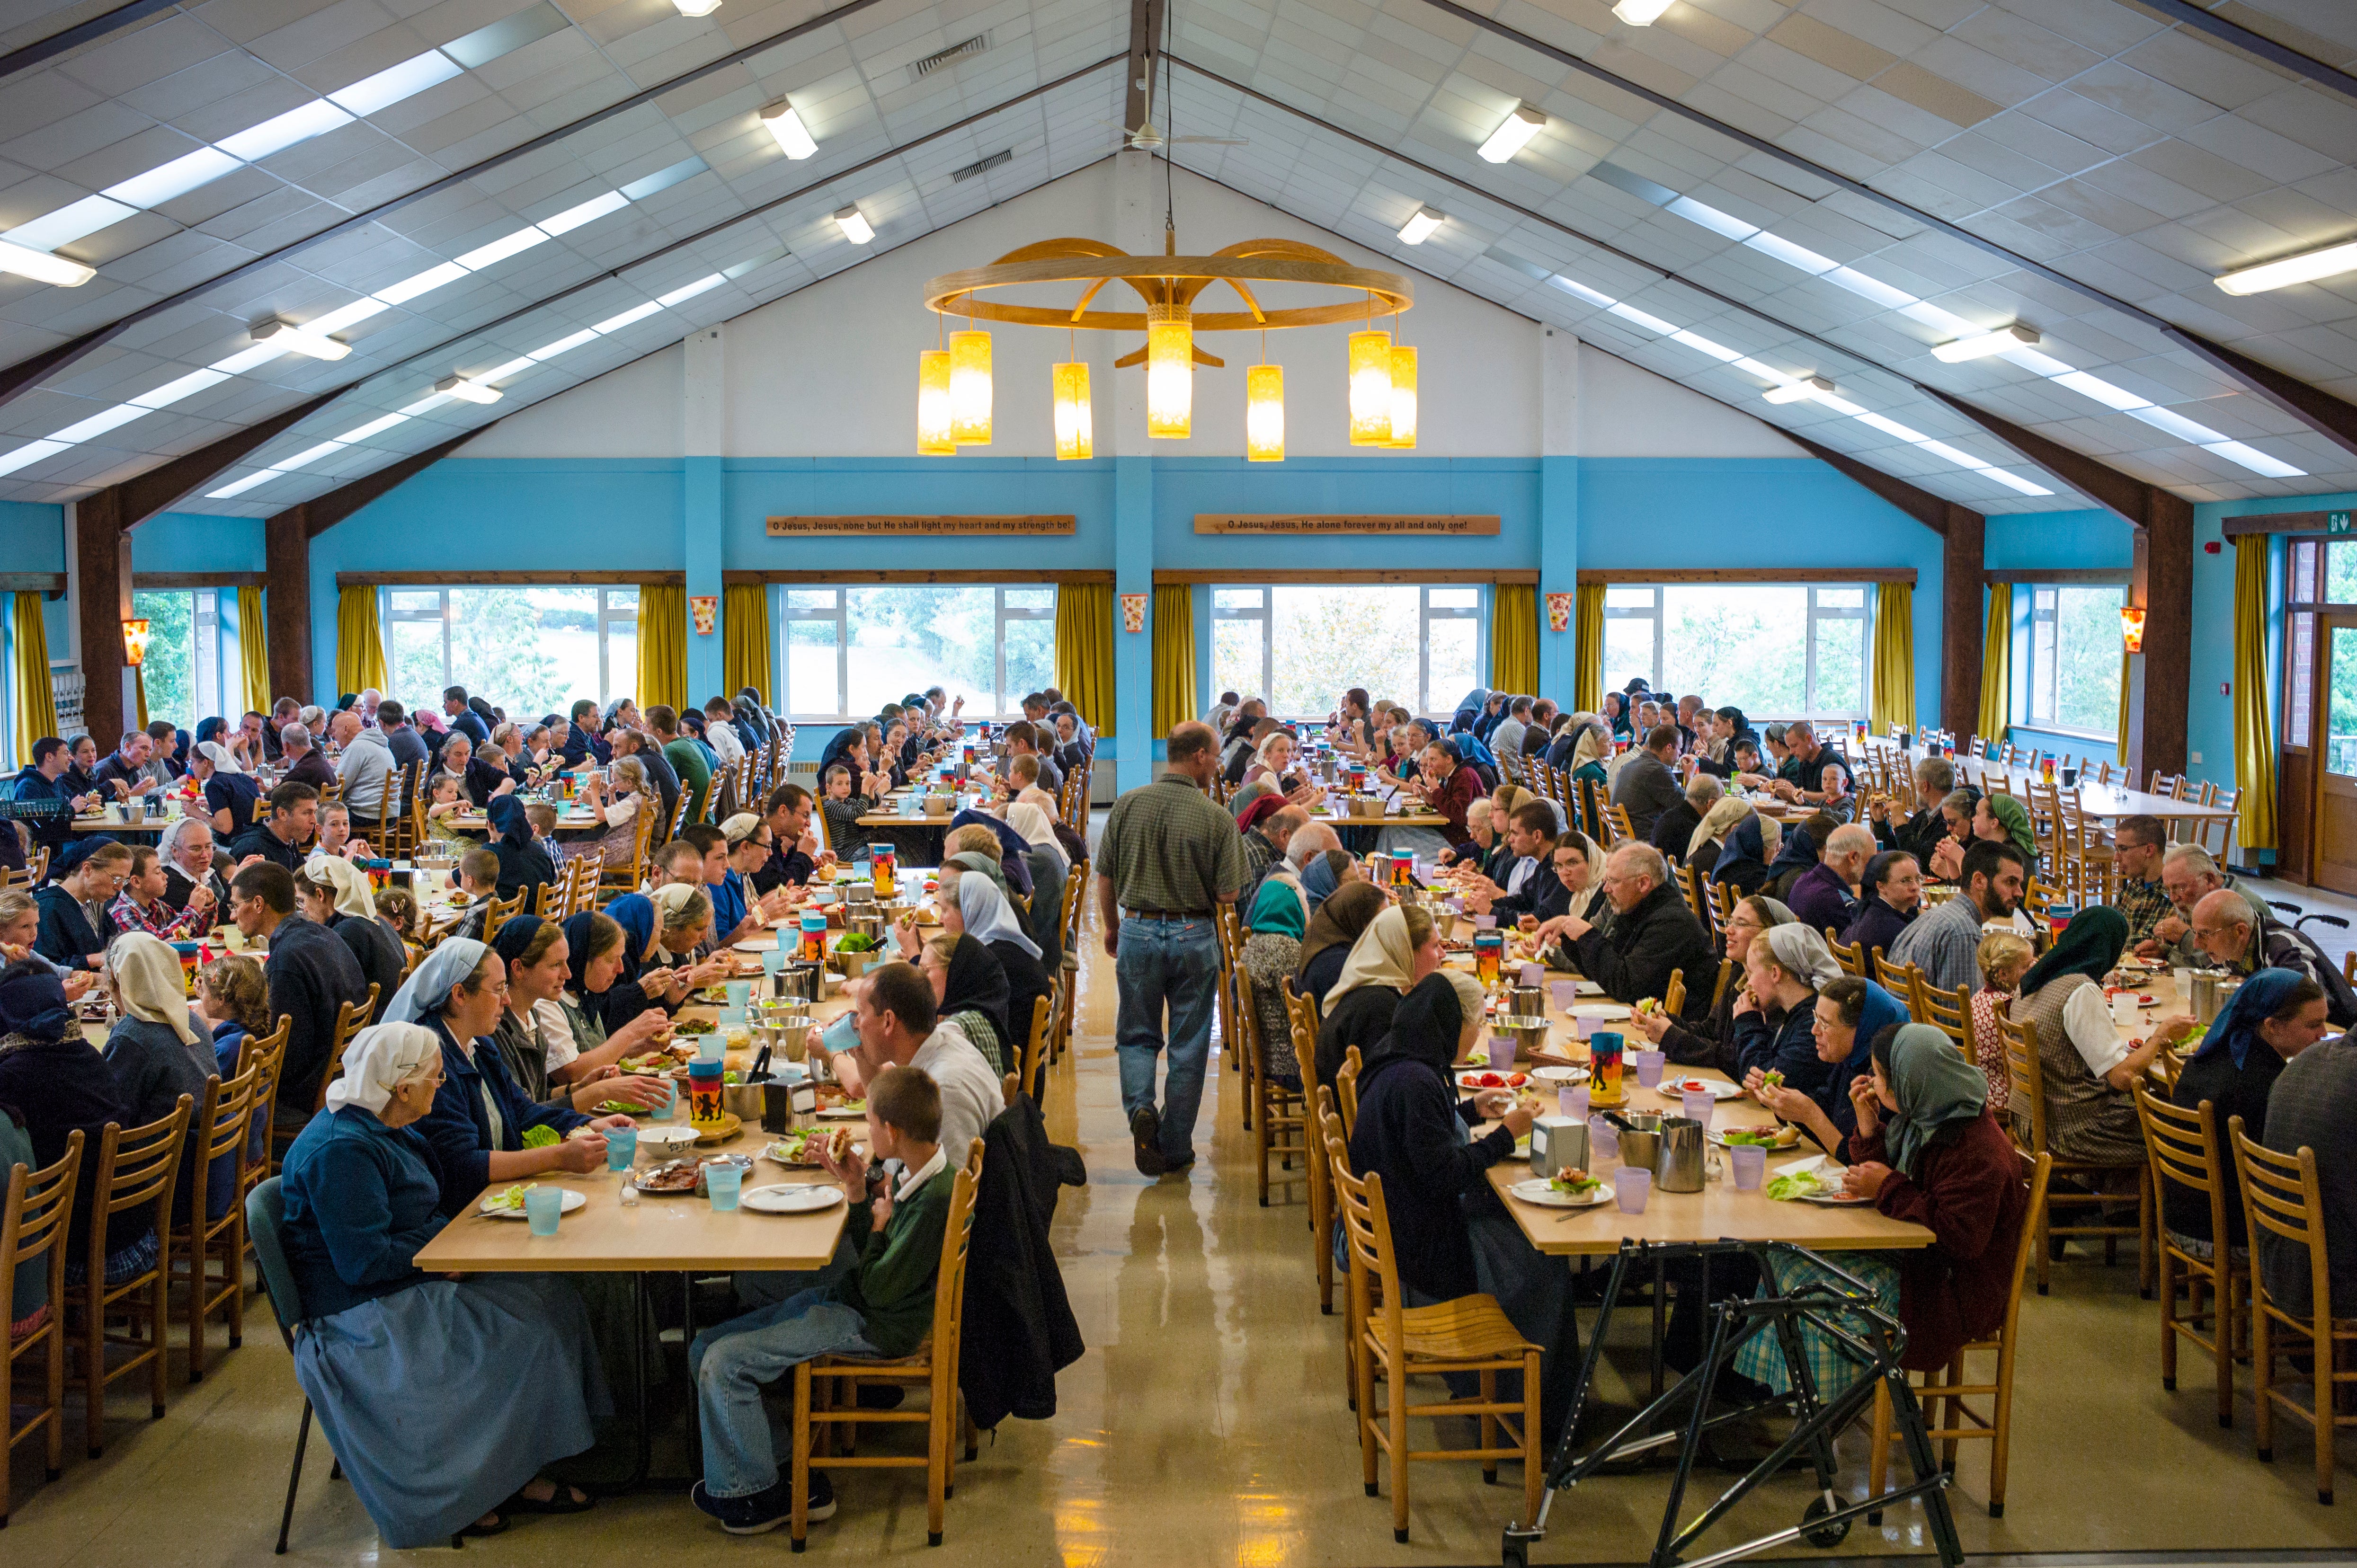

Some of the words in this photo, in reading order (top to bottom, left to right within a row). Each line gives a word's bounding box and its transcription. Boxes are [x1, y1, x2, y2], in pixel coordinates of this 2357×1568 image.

[773, 522, 779, 530] O
[782, 522, 810, 532] Jesus,
[813, 522, 841, 532] Jesus,
[867, 521, 881, 529] but
[884, 521, 896, 529] He
[898, 521, 919, 529] shall
[922, 521, 941, 531] light
[943, 523, 956, 531] my
[959, 521, 982, 529] heart
[984, 521, 1000, 529] and
[1003, 523, 1016, 531] my
[1018, 521, 1054, 531] strength
[1057, 521, 1070, 529] be!
[1238, 521, 1266, 530] Jesus,
[1270, 521, 1299, 530] Jesus,
[1302, 521, 1314, 529] He
[1316, 521, 1341, 529] alone
[1344, 521, 1376, 529] forever
[1379, 523, 1392, 531] my
[1394, 521, 1405, 529] all
[1408, 521, 1424, 529] and
[1427, 521, 1445, 531] only
[1448, 521, 1467, 529] one!
